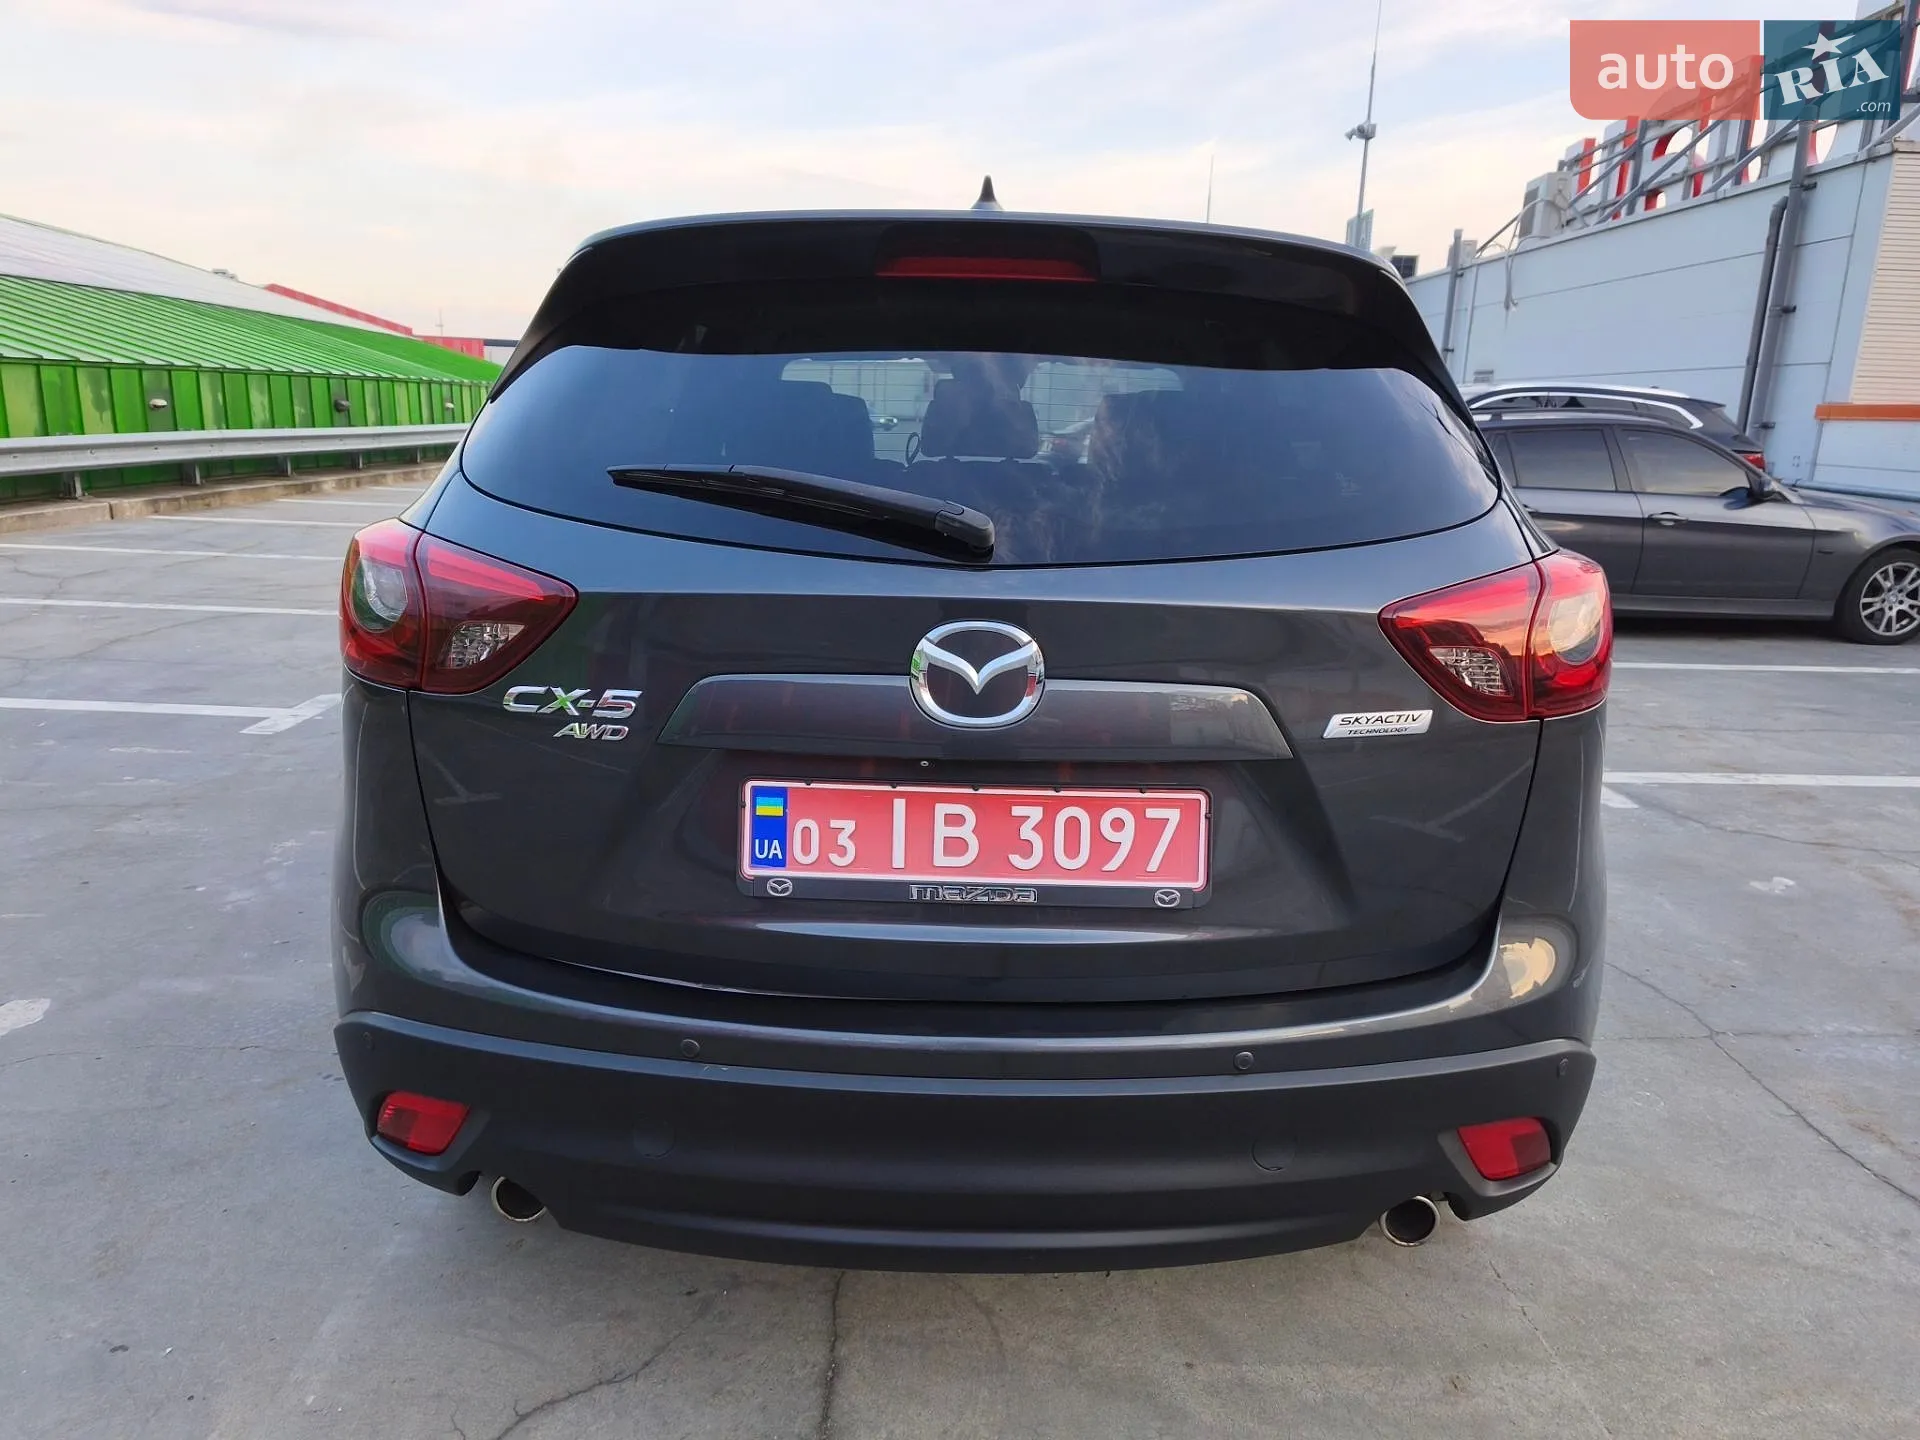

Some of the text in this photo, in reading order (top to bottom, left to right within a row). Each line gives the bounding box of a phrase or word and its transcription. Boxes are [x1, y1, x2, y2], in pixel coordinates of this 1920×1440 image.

[502, 685, 643, 718] CX-5
[1339, 714, 1422, 726] SKYACTIV
[553, 722, 629, 741] AWD
[1347, 727, 1409, 735] TECHNOLOGY
[792, 818, 857, 867] 03
[1007, 806, 1182, 872] 3097
[755, 839, 783, 860] UA
